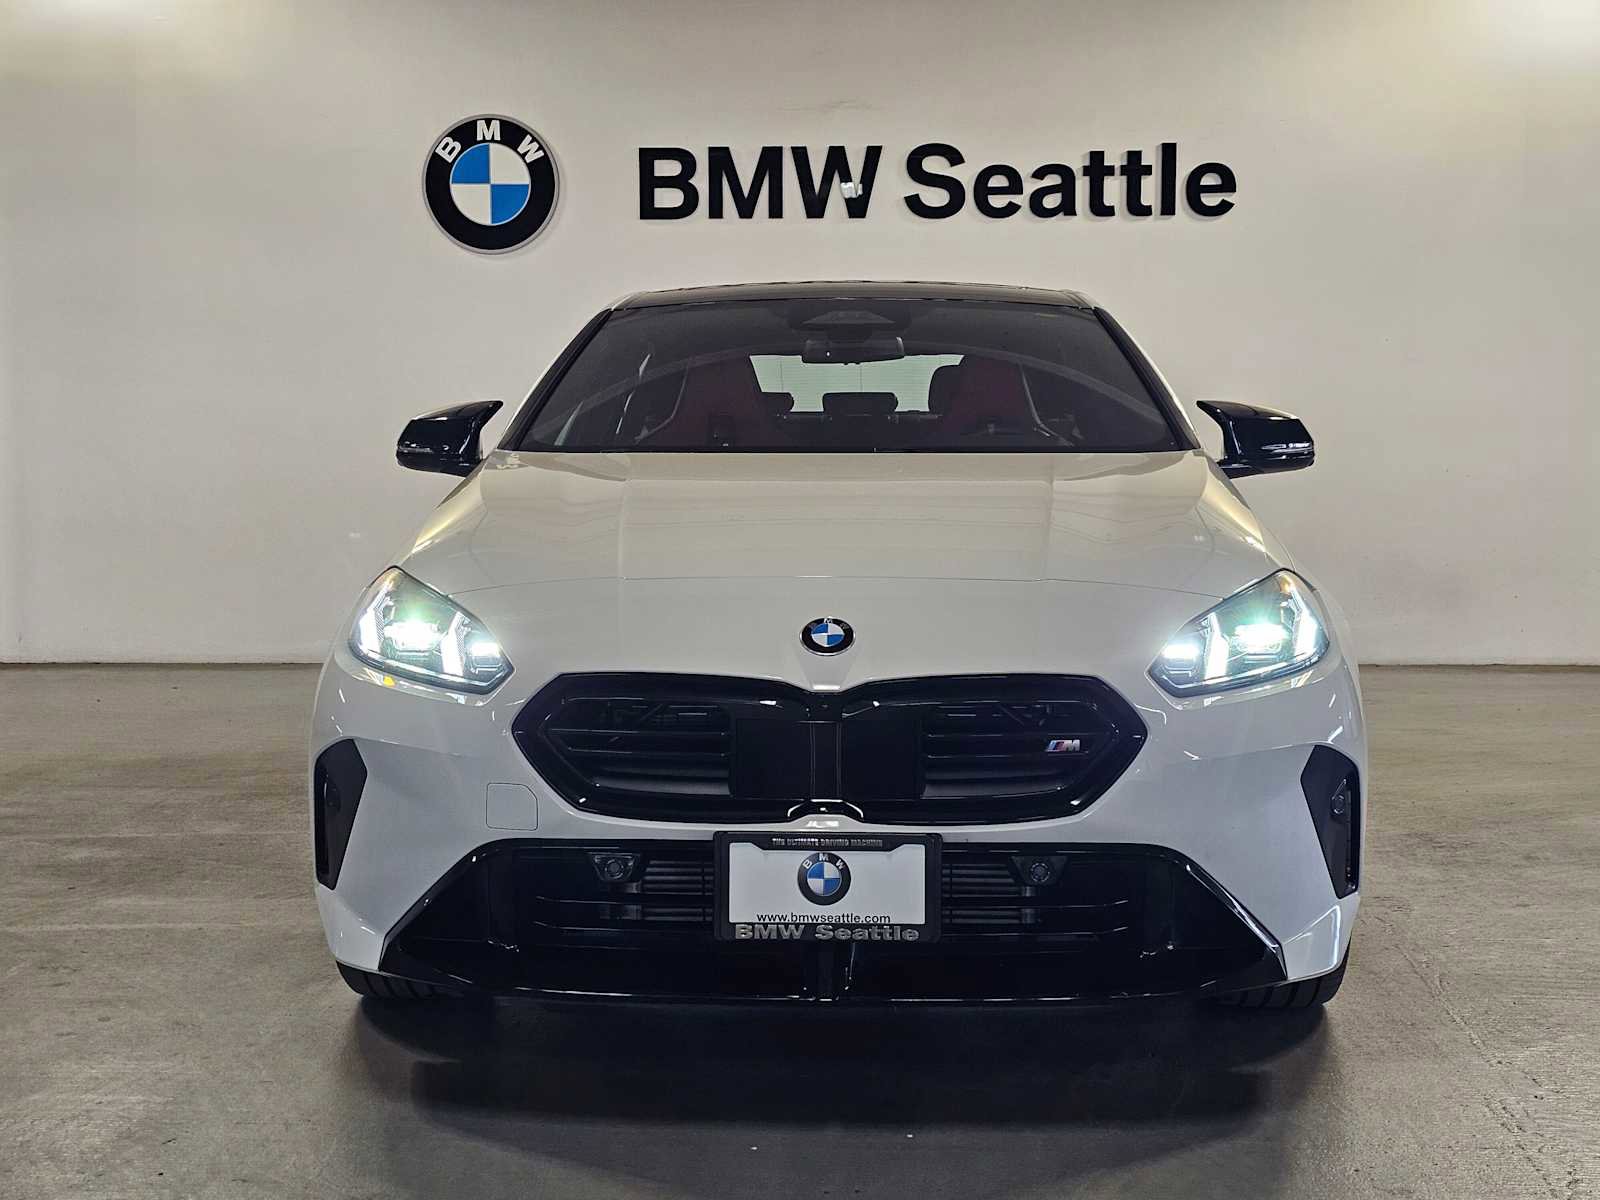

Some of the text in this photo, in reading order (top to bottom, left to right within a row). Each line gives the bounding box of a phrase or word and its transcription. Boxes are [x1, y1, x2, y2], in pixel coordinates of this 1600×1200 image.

[435, 120, 544, 163] BMW
[639, 142, 1237, 220] BMW Seattle
[802, 853, 845, 870] BMW
[756, 912, 891, 923] www.bmwseattle.com
[735, 924, 919, 941] BMW Seattle
